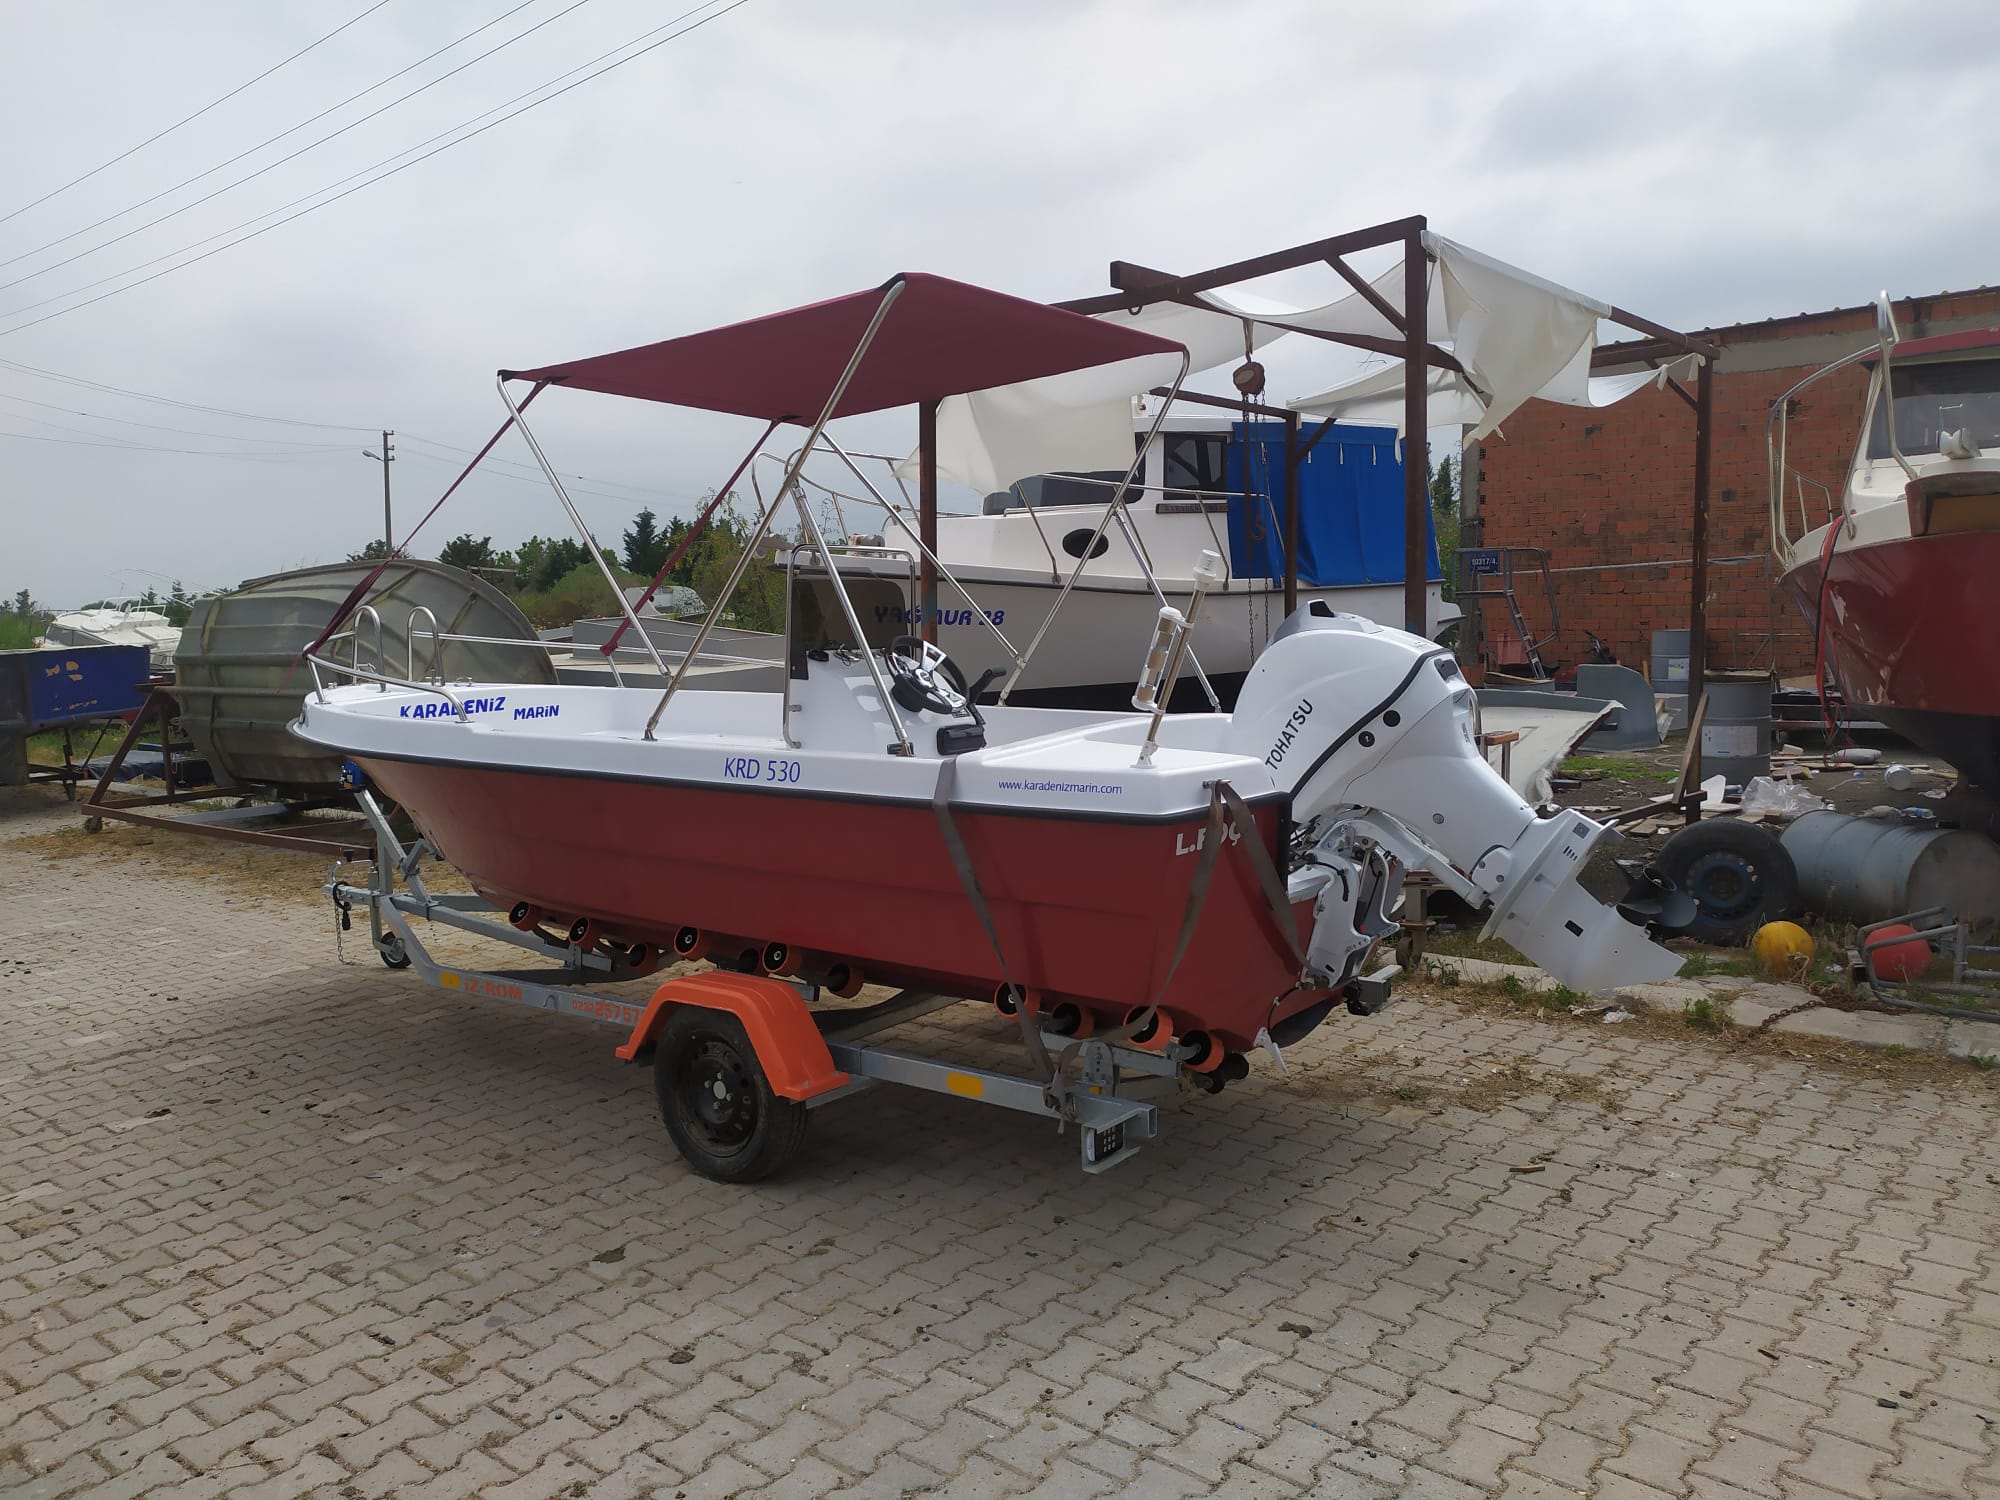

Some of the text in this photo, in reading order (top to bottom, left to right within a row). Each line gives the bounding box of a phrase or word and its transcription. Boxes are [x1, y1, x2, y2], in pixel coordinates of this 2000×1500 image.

[875, 605, 1006, 626] YAĞUR 28
[1265, 698, 1313, 770] TOHATSU
[723, 757, 801, 784] KRD 530
[998, 779, 1123, 795] www.karadenizmarin.com
